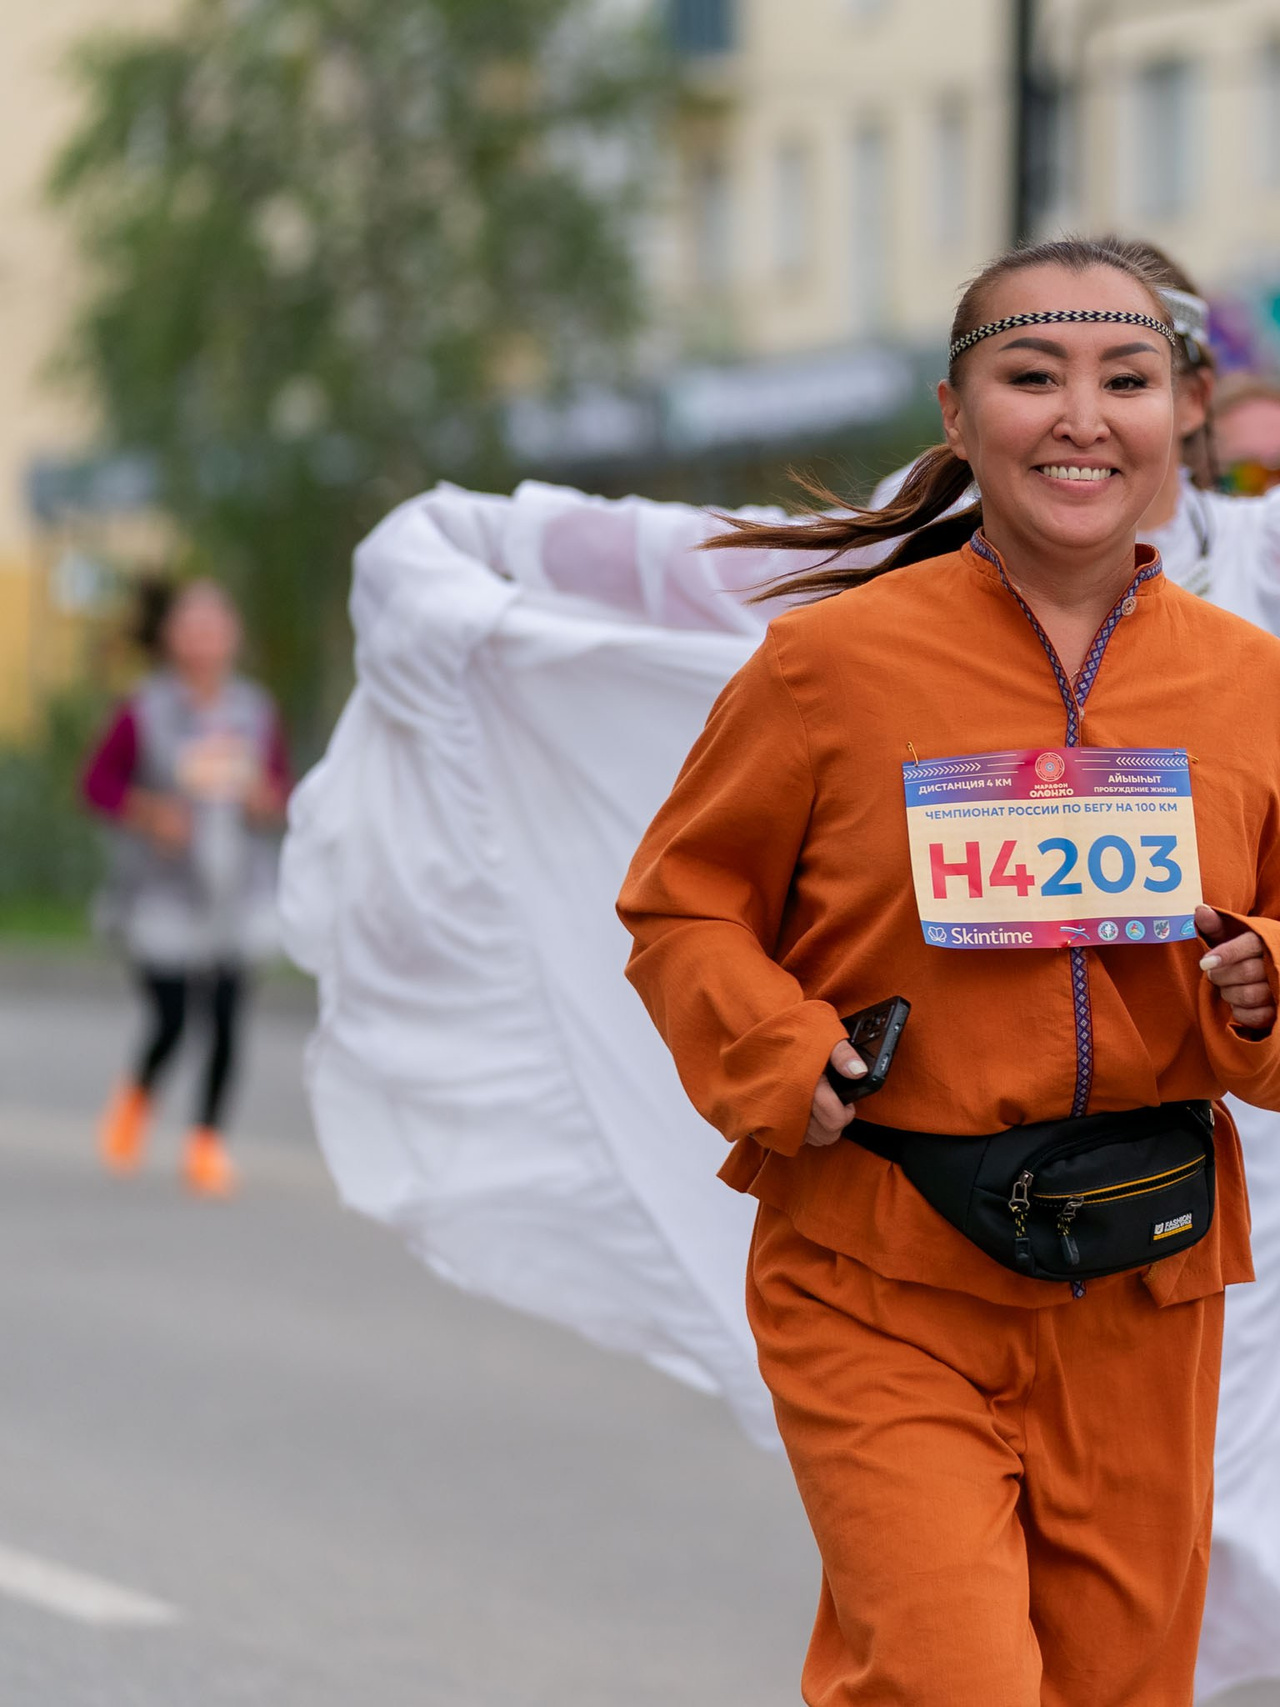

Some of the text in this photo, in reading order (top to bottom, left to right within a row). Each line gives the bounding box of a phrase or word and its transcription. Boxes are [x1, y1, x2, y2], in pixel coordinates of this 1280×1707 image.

[918, 778, 1012, 795] ДИСТАНЦИЯ 4 КМ
[1094, 786, 1149, 794] ПРОБУЖДЕНИЕ
[925, 803, 1177, 820] ЧЕМПИОНАТ РОССИИ ПО БЕГУ НА 100 КМ
[951, 927, 1033, 945] Skintime
